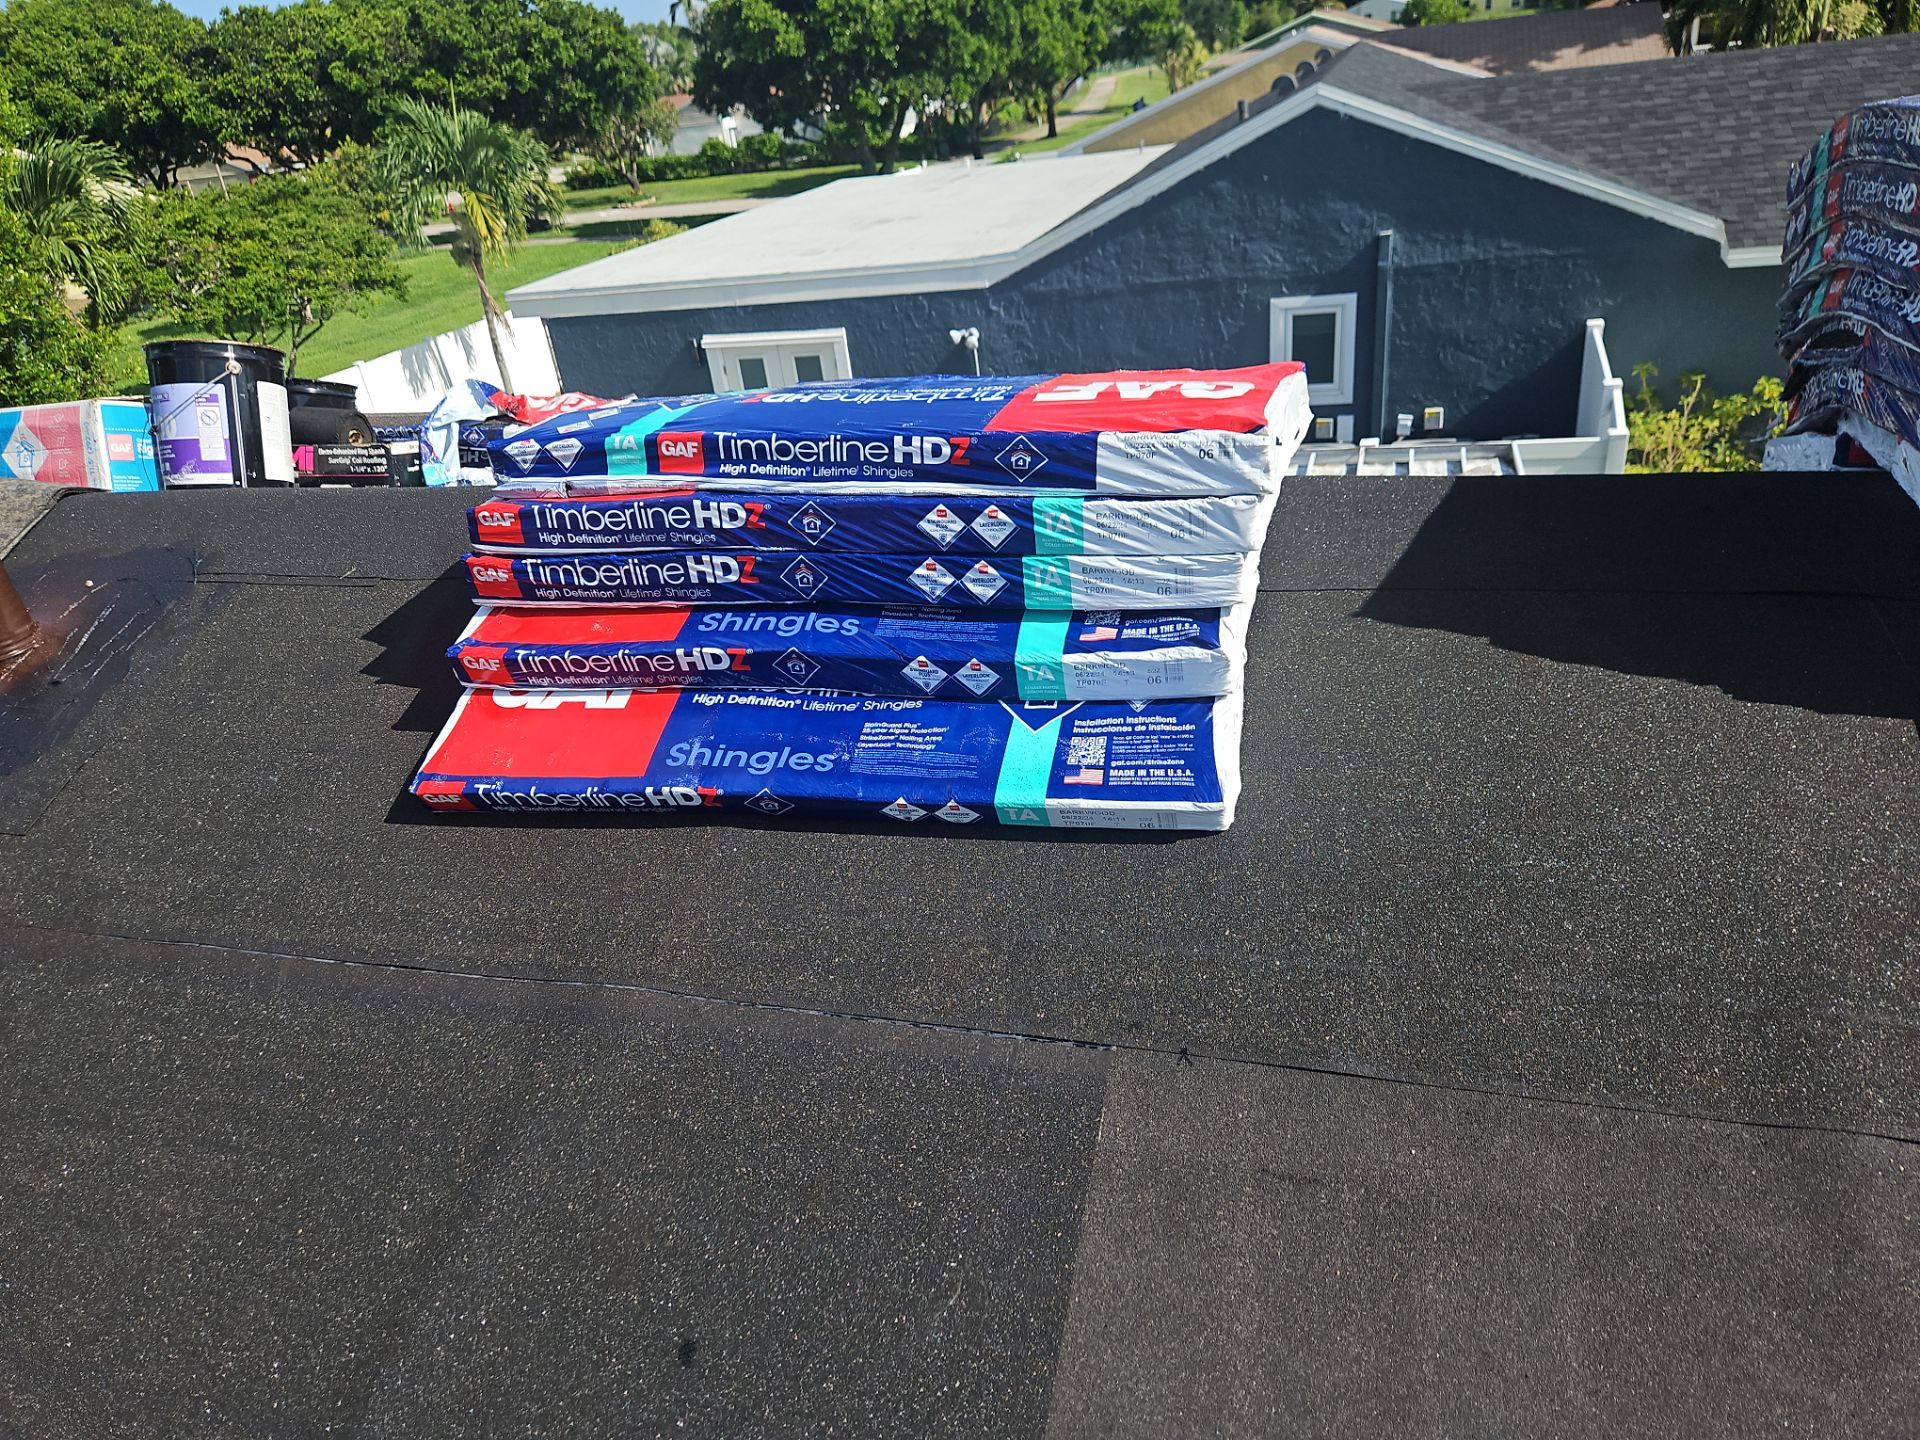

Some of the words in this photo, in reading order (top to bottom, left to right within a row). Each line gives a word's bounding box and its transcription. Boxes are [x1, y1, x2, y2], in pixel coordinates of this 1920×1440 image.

[1033, 381, 1255, 402] GAF
[614, 434, 638, 449] TA
[661, 440, 700, 458] GAF
[713, 431, 889, 463] Timberline
[1199, 449, 1214, 460] 06
[352, 457, 362, 465] Coil
[363, 457, 387, 467] Roofing
[719, 463, 747, 476] High
[863, 467, 914, 479] Shingles
[478, 511, 518, 527] GAF
[532, 502, 691, 531] Timberline
[1041, 511, 1077, 535] TA
[539, 532, 566, 546] High
[669, 532, 717, 546] Shingles
[1171, 529, 1186, 540] 06
[473, 566, 509, 582] GAF
[521, 558, 686, 586] Timberline
[1031, 565, 1064, 588] TA
[537, 588, 562, 600] High
[666, 586, 712, 600] Shingles
[1157, 586, 1172, 597] 06
[698, 612, 861, 638] Shingles
[1122, 627, 1147, 635] MADE
[1149, 626, 1158, 635] IN
[1159, 624, 1175, 633] THE
[1176, 622, 1201, 631] U.S.A.
[463, 655, 501, 671] GAF
[515, 649, 678, 674] Timberline
[1025, 664, 1056, 682] TA
[1147, 675, 1162, 685] 06
[528, 676, 553, 687] High
[658, 675, 703, 686] Shingles
[693, 693, 724, 708] High
[863, 699, 923, 712] Shingles
[1075, 716, 1123, 727] Installation
[1126, 715, 1176, 725] Instructions
[1073, 725, 1132, 735] Instrucciones
[1134, 724, 1147, 733] de
[900, 735, 924, 743] Nailing
[924, 734, 943, 742] Area
[896, 742, 937, 751] Technology
[666, 741, 835, 776] Shingles
[1109, 769, 1136, 777] MADE
[423, 794, 462, 803] GAF
[474, 784, 648, 807] Timberline
[1002, 808, 1041, 821] TA
